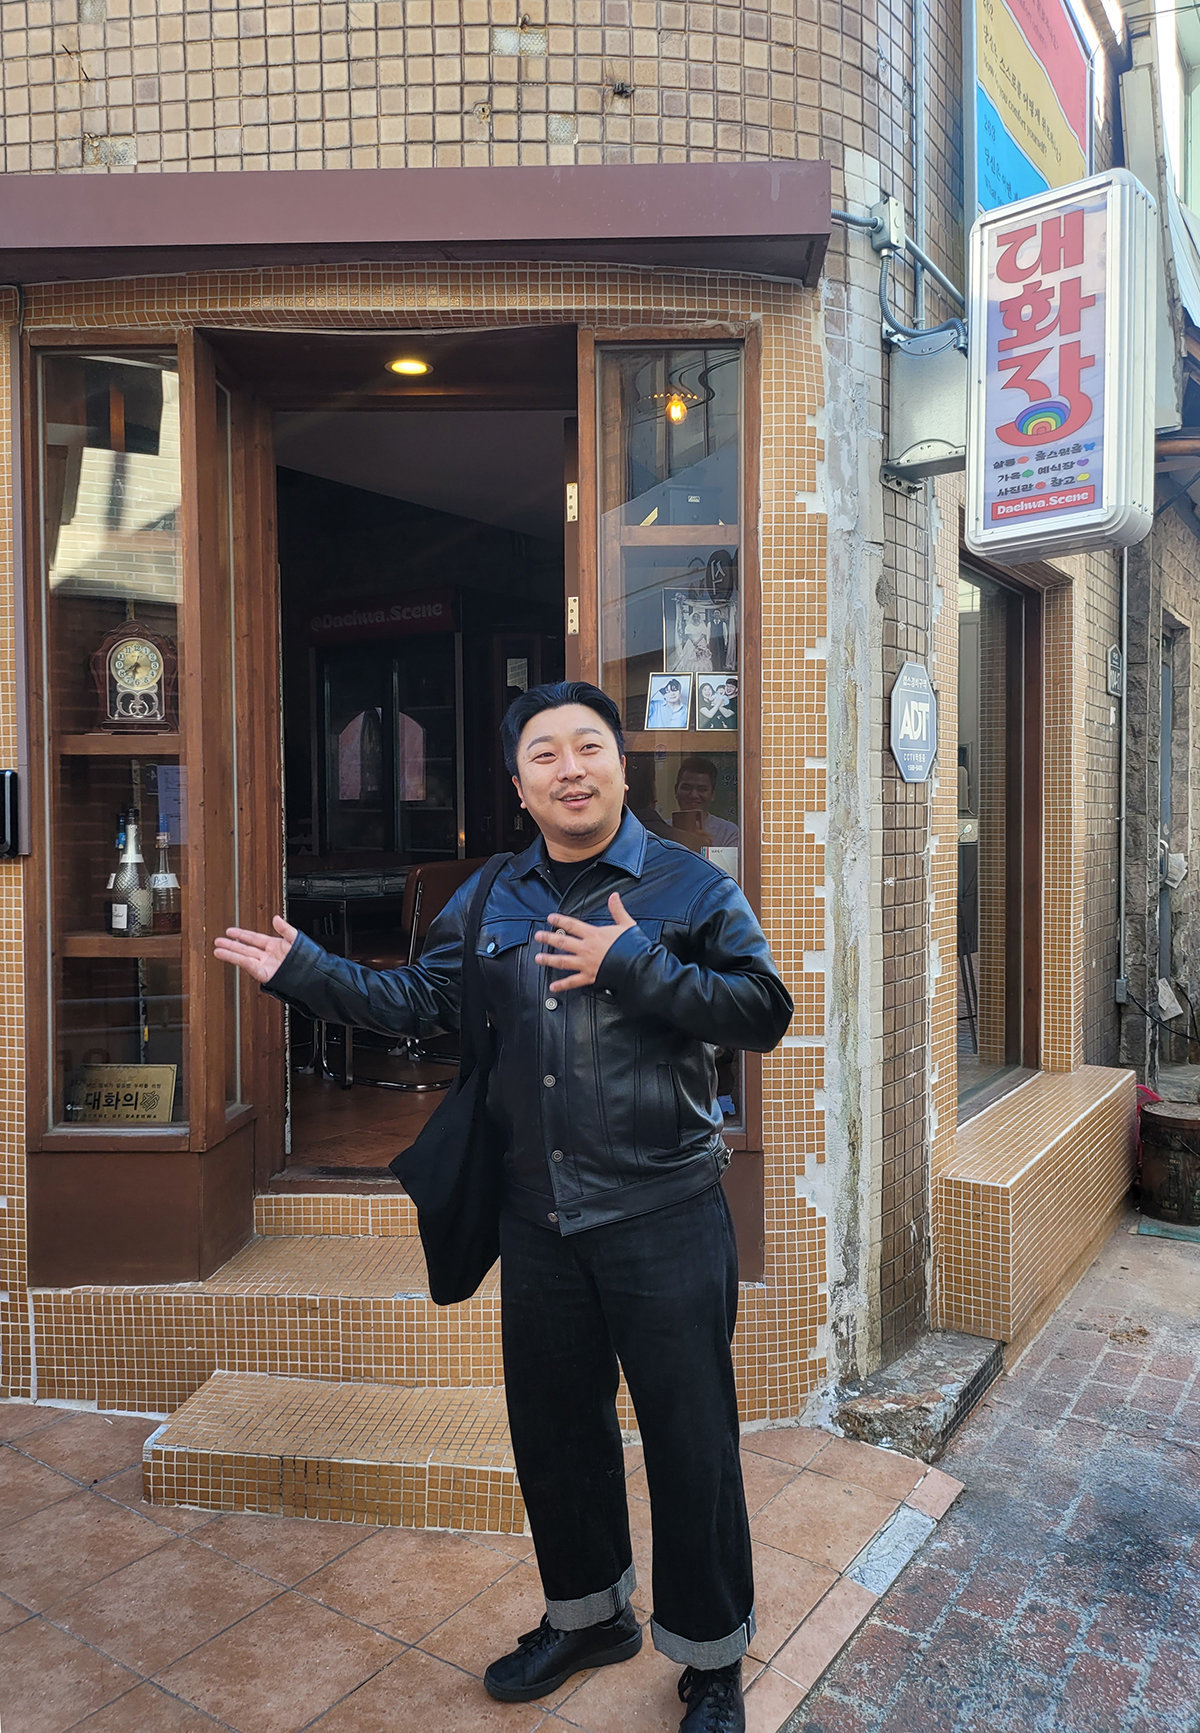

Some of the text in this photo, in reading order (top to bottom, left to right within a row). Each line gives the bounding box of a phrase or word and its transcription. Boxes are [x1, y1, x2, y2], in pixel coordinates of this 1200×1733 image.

[996, 208, 1097, 447] 대화장
[1037, 461, 1075, 475] 예식장
[997, 476, 1075, 497] 사진관 창고
[997, 492, 1089, 515] Daehwa.Scene
[311, 603, 443, 632] @Daehwa.Scene
[899, 701, 929, 741] ADT
